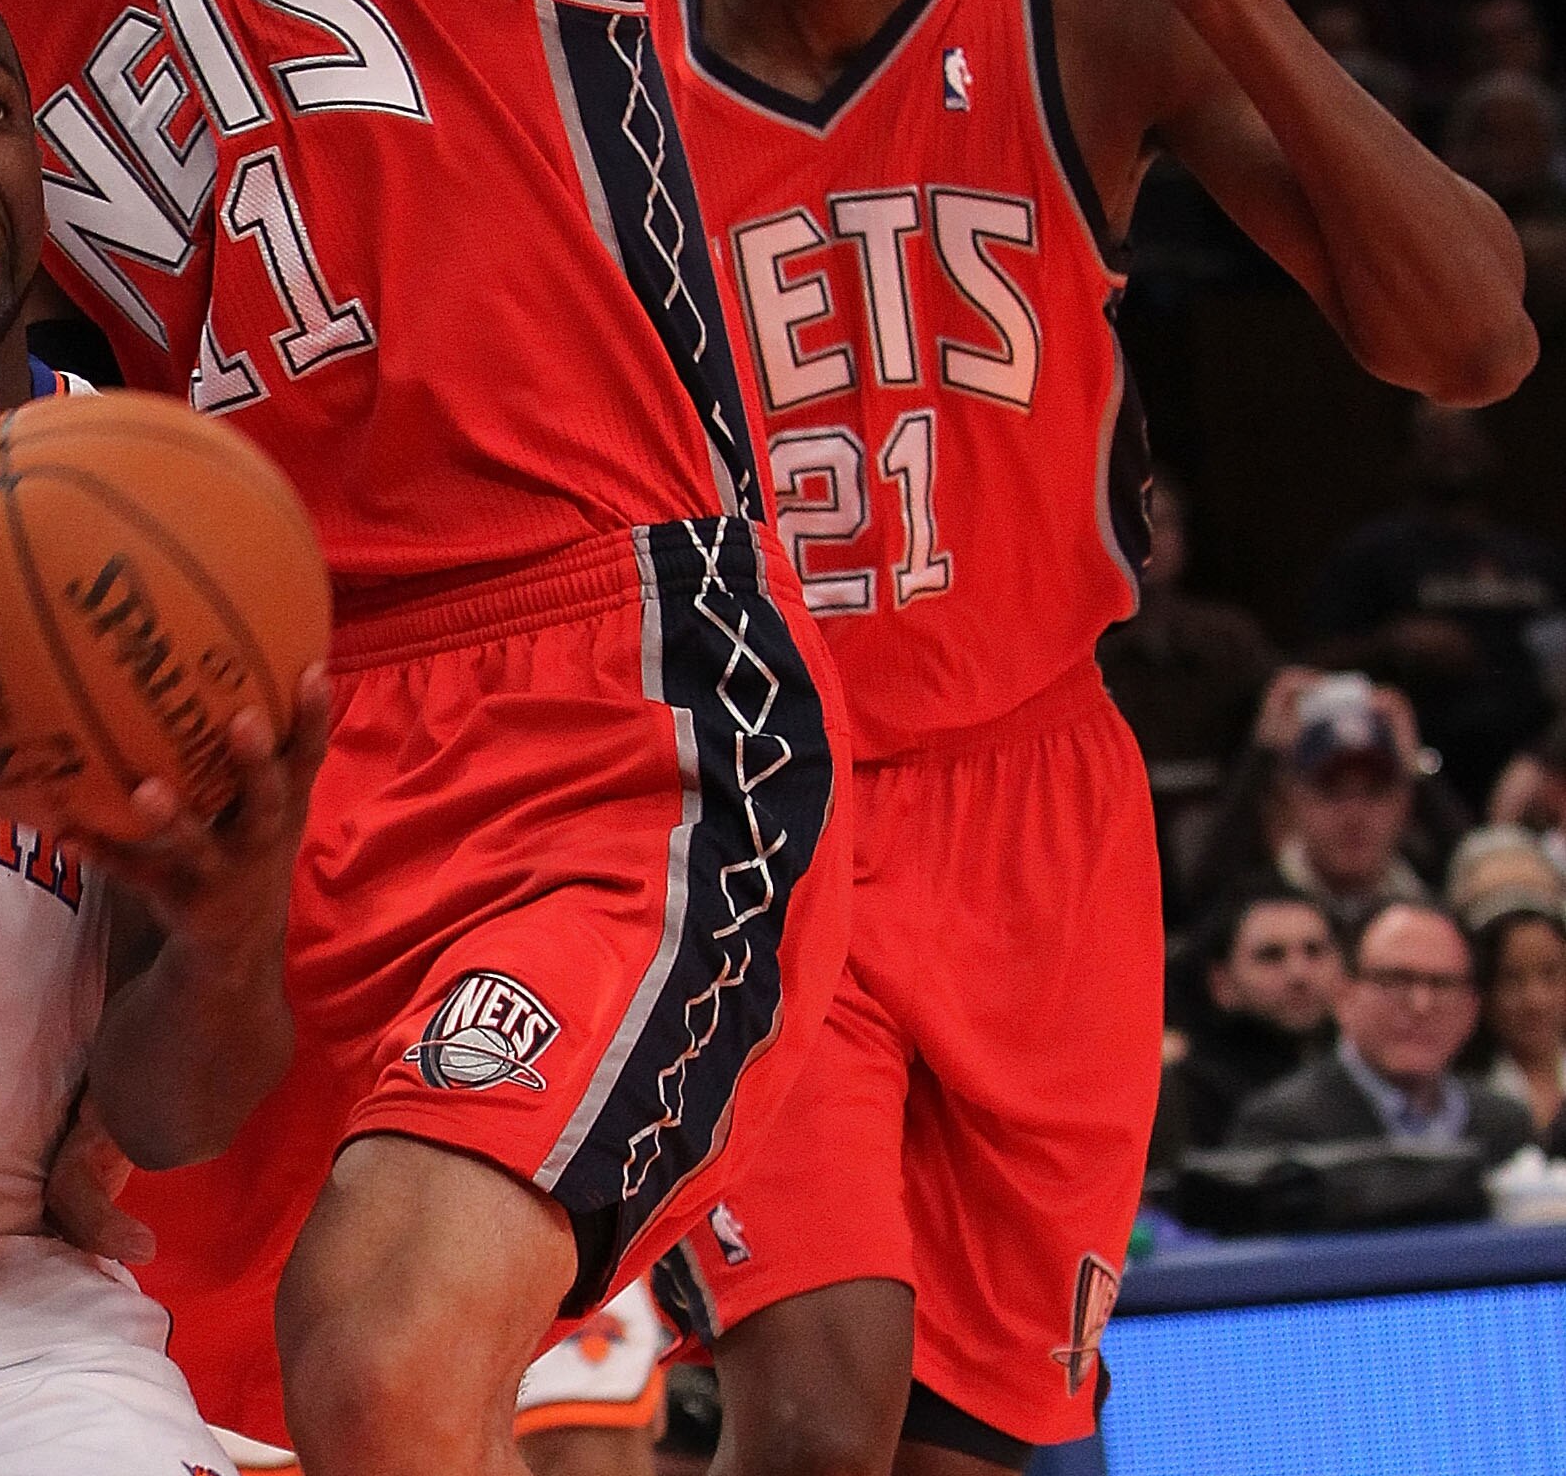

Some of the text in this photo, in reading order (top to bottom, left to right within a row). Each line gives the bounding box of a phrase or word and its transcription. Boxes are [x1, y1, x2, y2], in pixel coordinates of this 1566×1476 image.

[715, 184, 1044, 416] ETS
[770, 408, 954, 615] 21
[442, 976, 549, 1058] NETS
